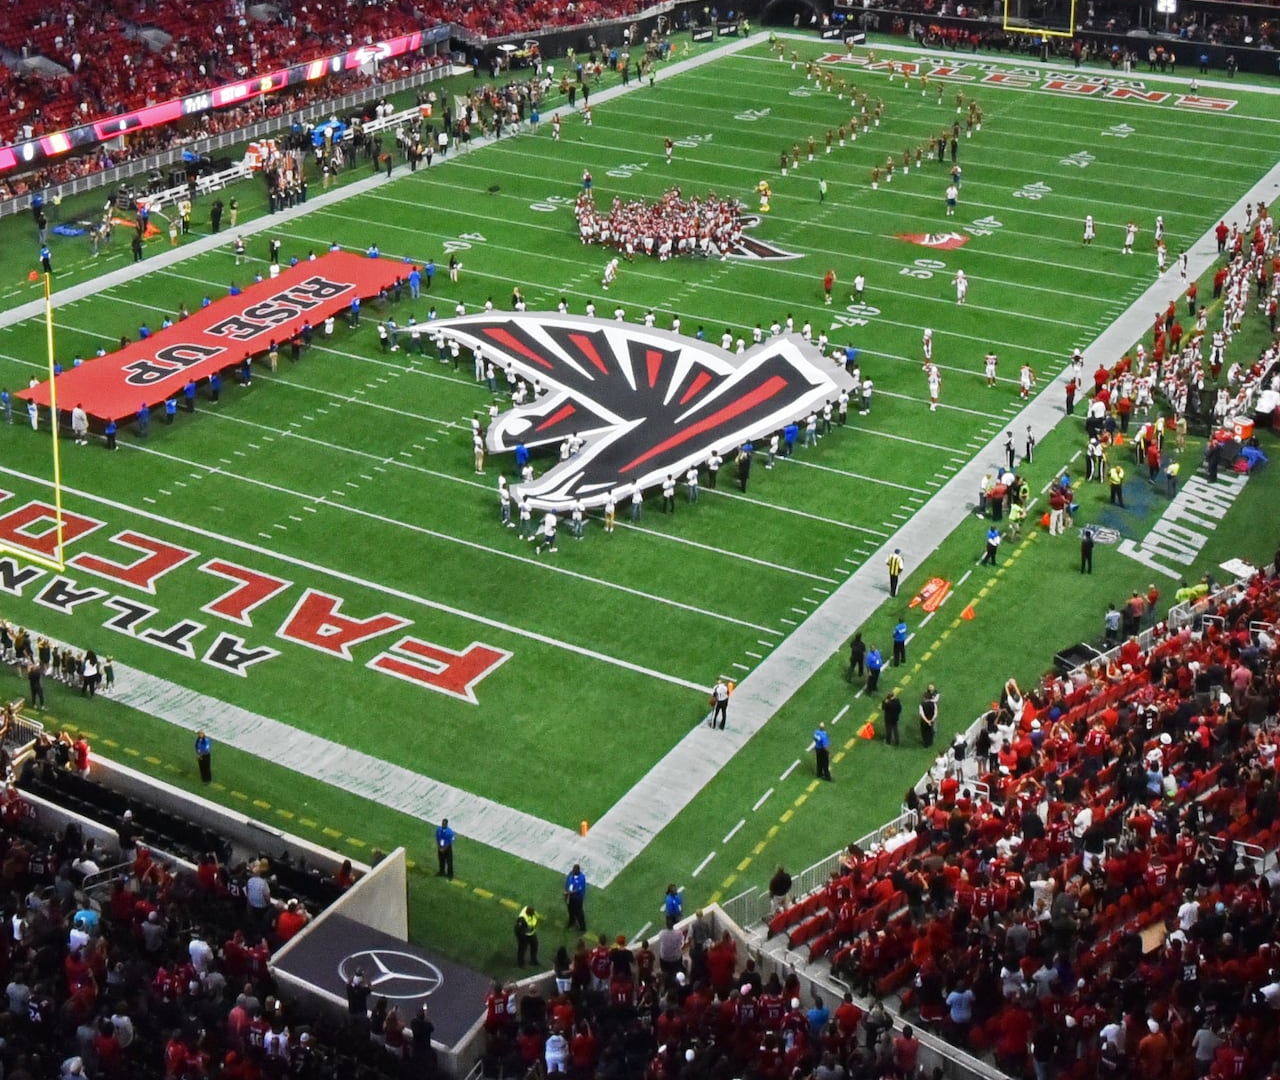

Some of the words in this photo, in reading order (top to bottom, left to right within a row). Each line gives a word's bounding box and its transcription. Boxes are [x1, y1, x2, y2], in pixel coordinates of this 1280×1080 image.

[816, 52, 1240, 114] FALCONS
[898, 258, 947, 280] 50
[203, 275, 357, 341] RISE
[832, 304, 882, 328] 40
[120, 342, 228, 387] UP
[1115, 469, 1251, 581] FOOTBALL
